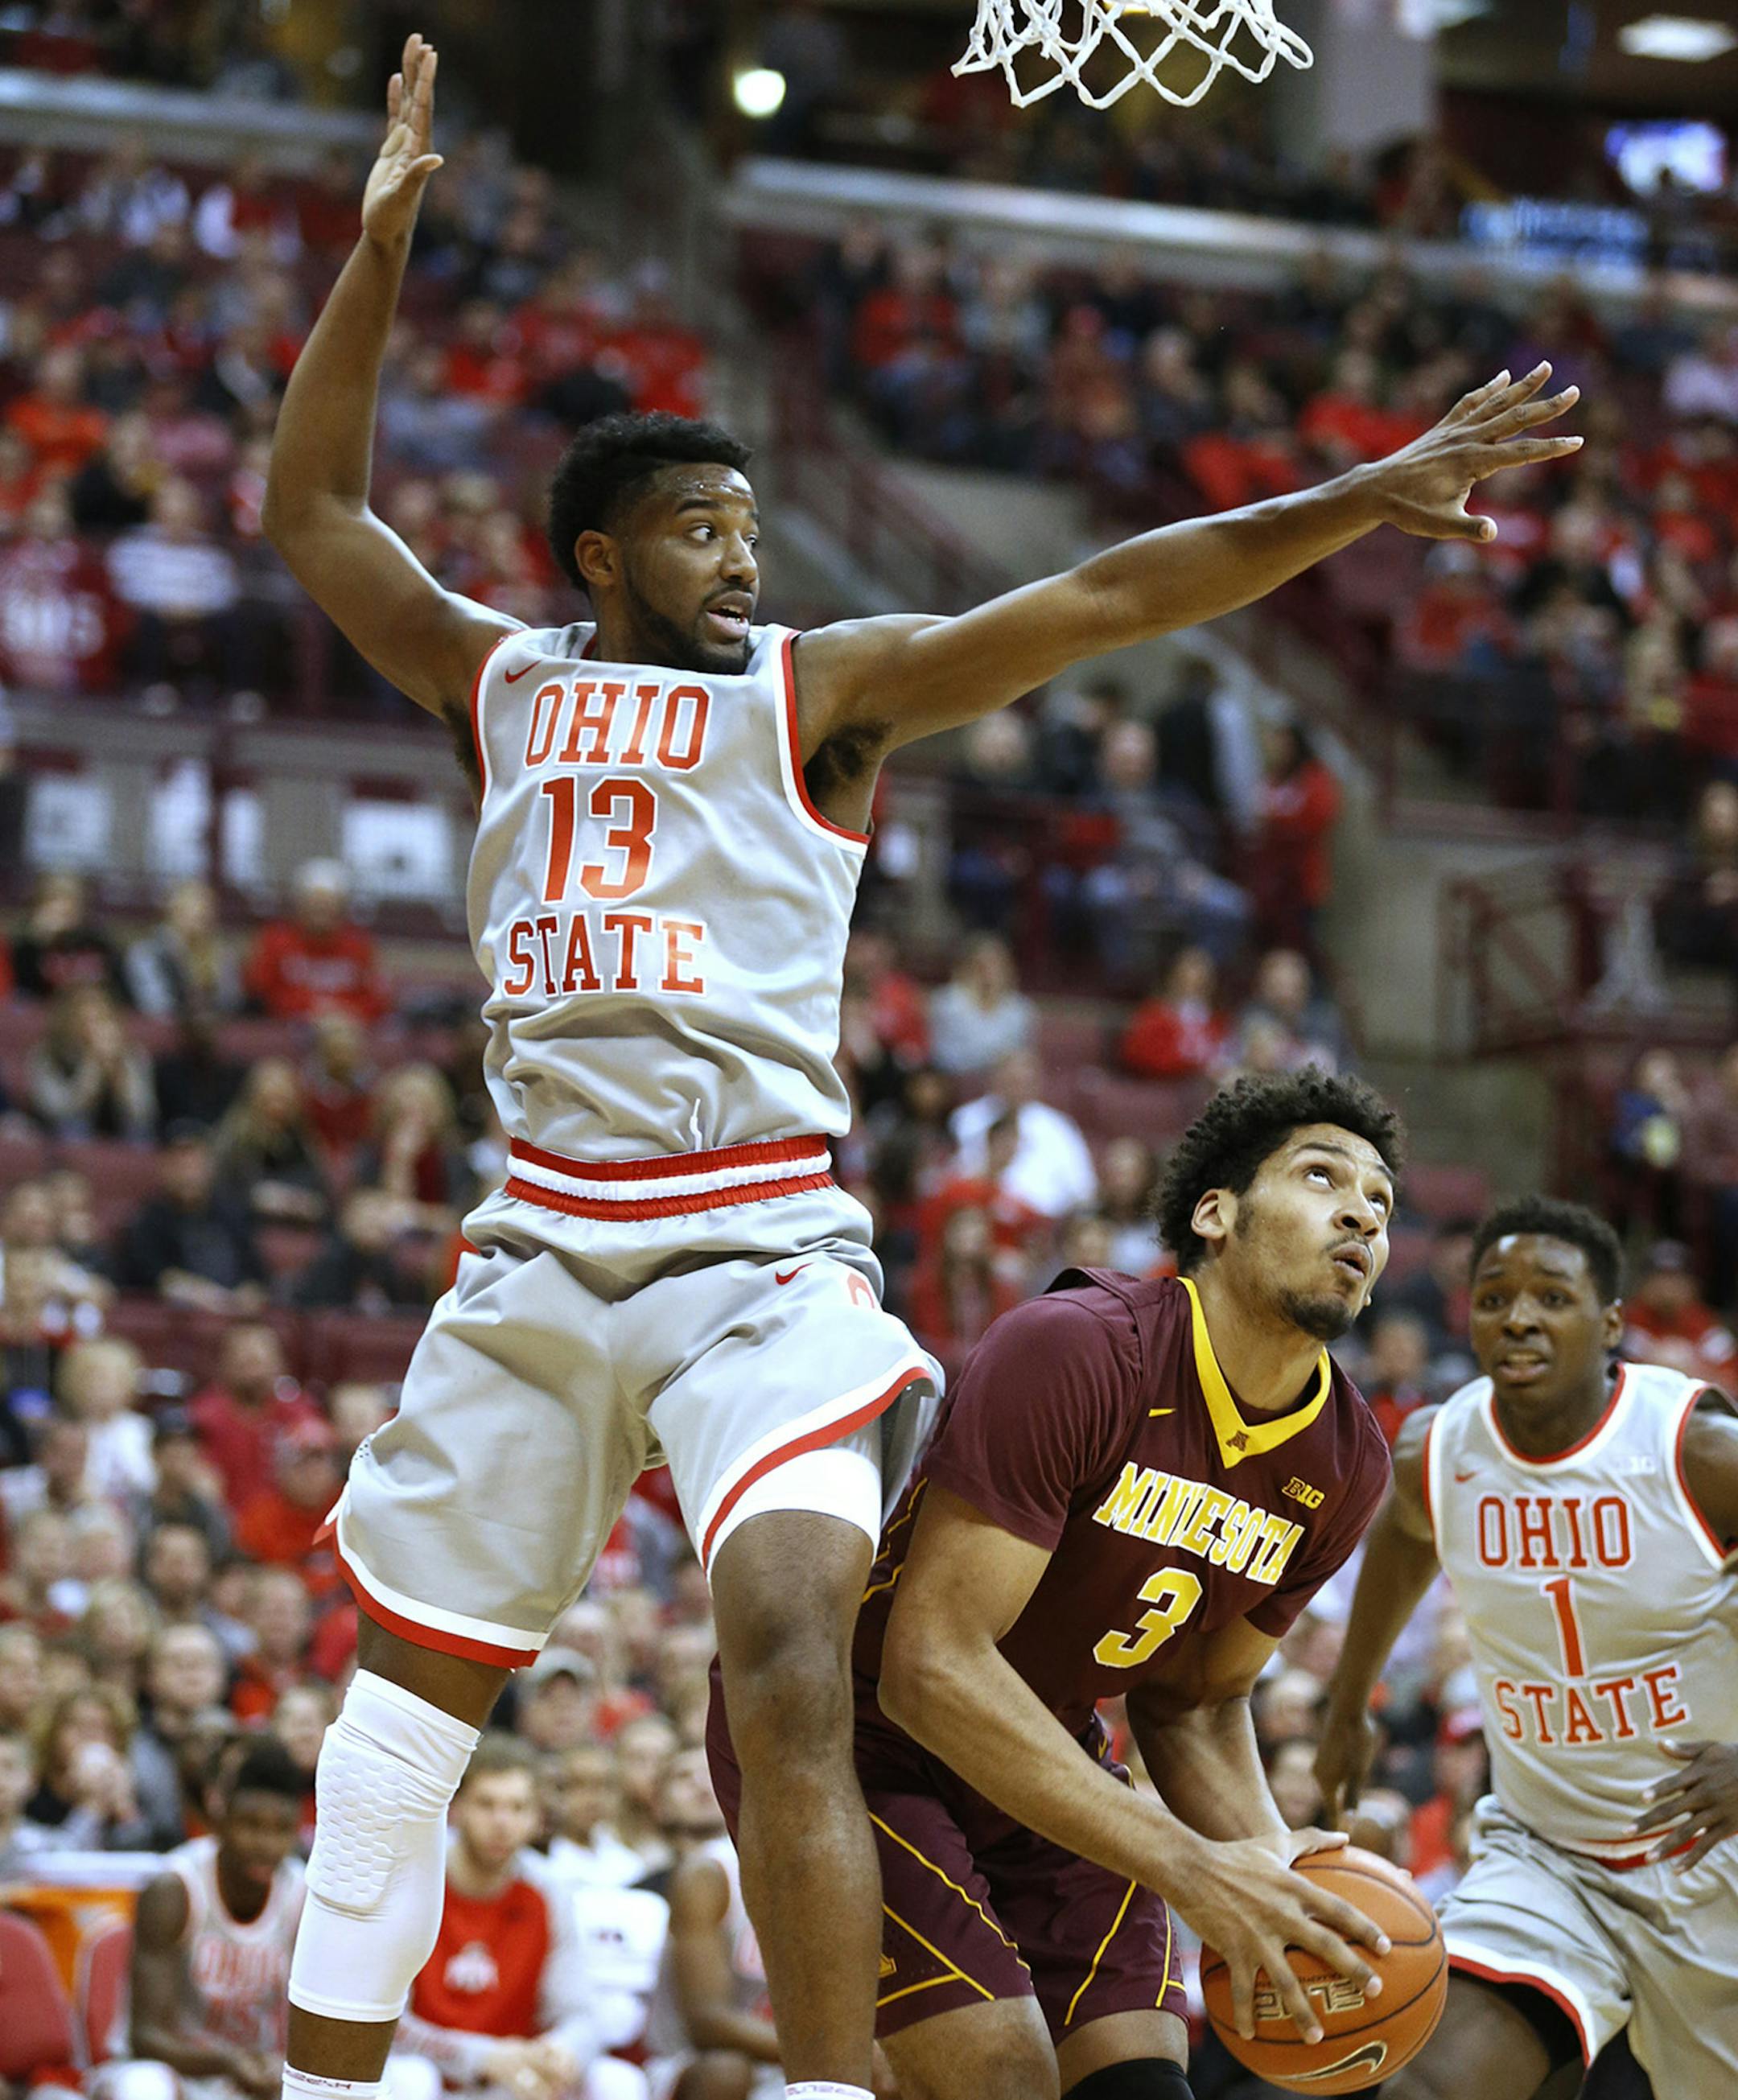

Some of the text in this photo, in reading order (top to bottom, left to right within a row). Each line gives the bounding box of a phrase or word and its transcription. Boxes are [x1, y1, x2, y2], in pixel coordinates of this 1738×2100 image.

[525, 681, 712, 772] OHIO
[540, 775, 657, 904] 13
[503, 911, 706, 999] STATE
[1477, 1490, 1635, 1571] OHIO
[1093, 1567, 1203, 1669] 3
[1540, 1575, 1588, 1680] 1
[1493, 1661, 1690, 1746] STATE
